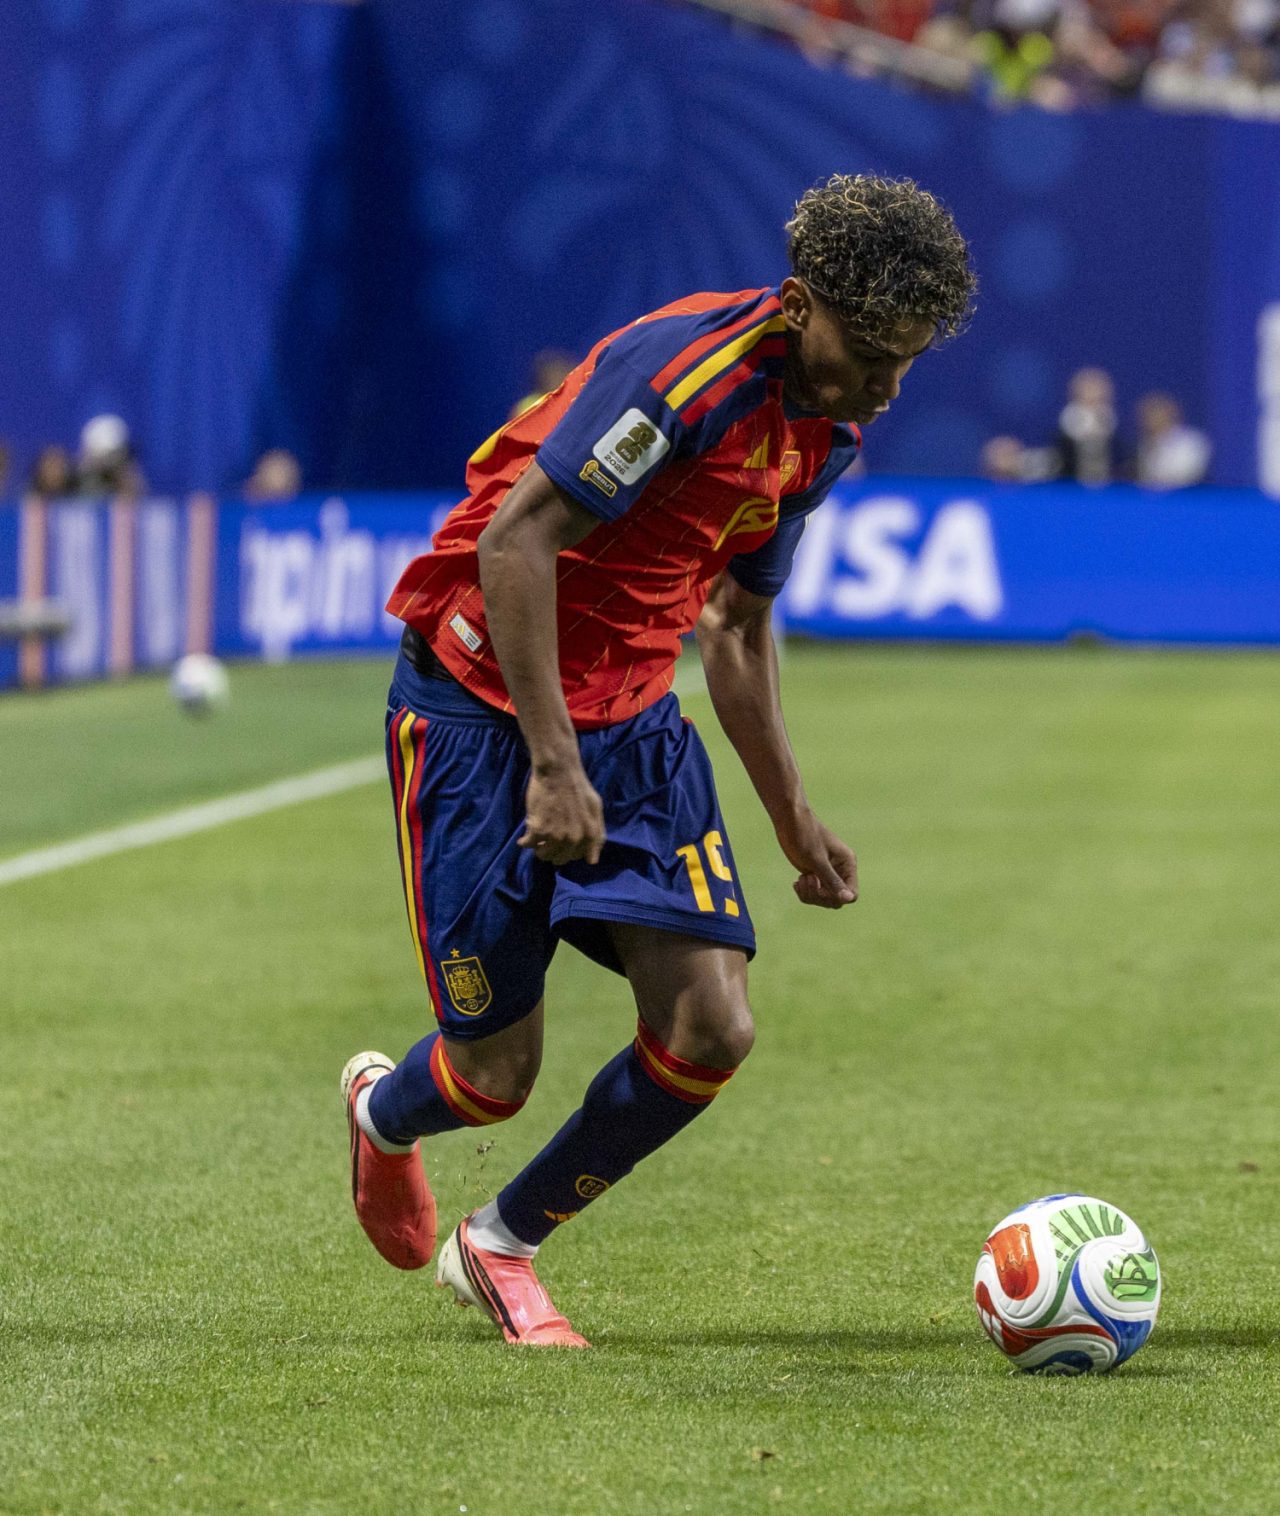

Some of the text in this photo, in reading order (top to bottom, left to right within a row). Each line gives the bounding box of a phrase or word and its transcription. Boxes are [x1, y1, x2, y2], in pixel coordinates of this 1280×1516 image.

[604, 454, 626, 476] 2026
[592, 471, 614, 491] DEBUT
[785, 497, 1002, 620] ISA
